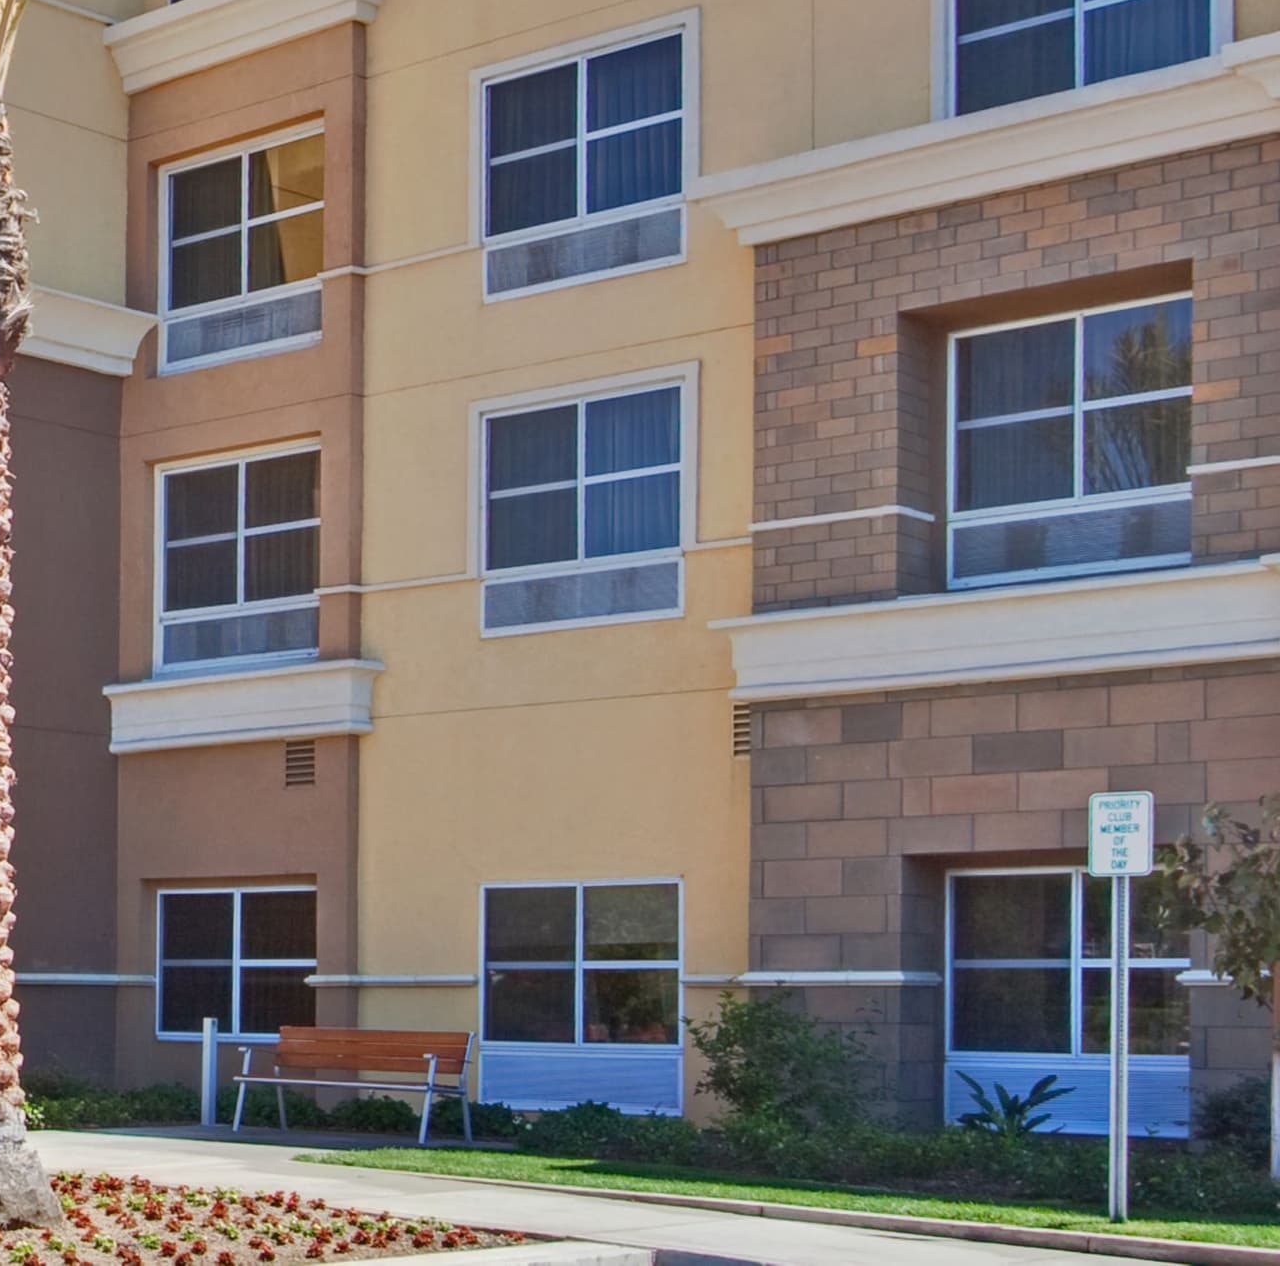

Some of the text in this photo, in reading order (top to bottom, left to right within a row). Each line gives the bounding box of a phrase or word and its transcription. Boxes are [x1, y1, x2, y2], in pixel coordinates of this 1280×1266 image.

[1099, 800, 1140, 810] PRIORITY
[1108, 813, 1132, 822] CLUB
[1100, 824, 1139, 834] MEMBER
[1113, 836, 1125, 846] OF
[1112, 848, 1128, 858] THE
[1111, 860, 1127, 870] DAY
